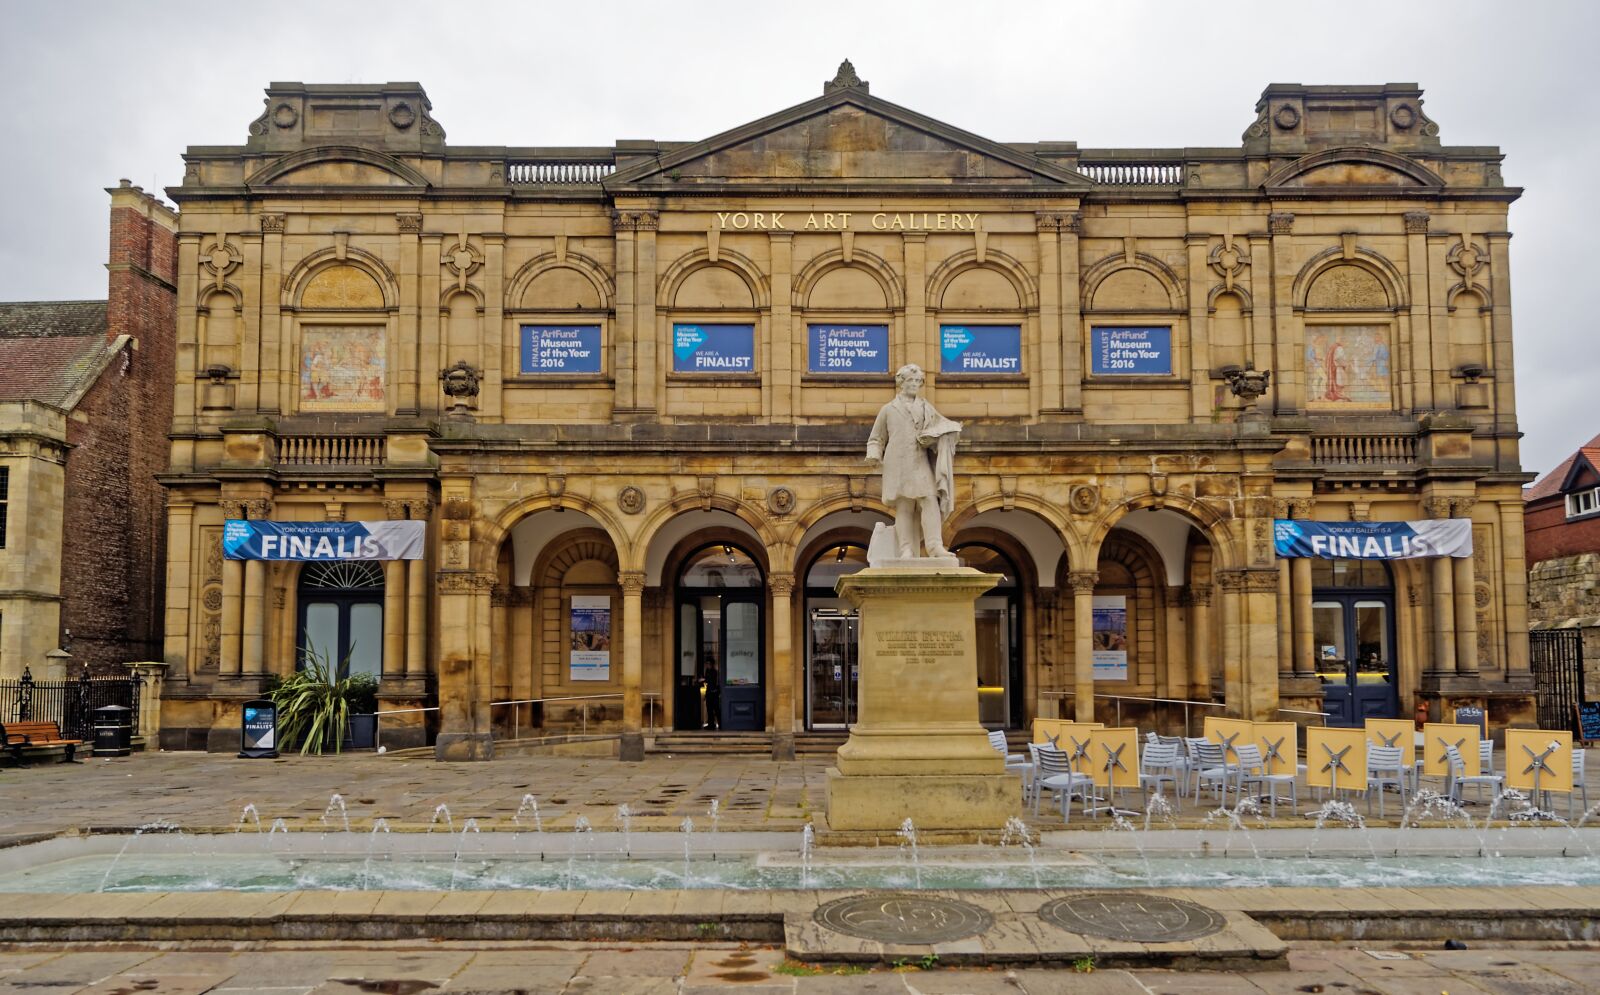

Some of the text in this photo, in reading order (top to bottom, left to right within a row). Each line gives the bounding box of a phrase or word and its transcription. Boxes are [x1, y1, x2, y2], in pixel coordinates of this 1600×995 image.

[717, 212, 979, 229] YORK ART GALLERY
[540, 339, 582, 348] Museum
[828, 338, 869, 347] Museum
[1110, 340, 1151, 349] Museum
[540, 349, 590, 358] of the Year
[828, 348, 878, 357] of the Year
[1110, 350, 1160, 358] of the Year
[540, 359, 565, 368] 2016
[696, 357, 751, 367] FINALIST
[828, 358, 852, 367] 2016
[963, 358, 1018, 368] FINALIST
[1110, 359, 1135, 368] 2016
